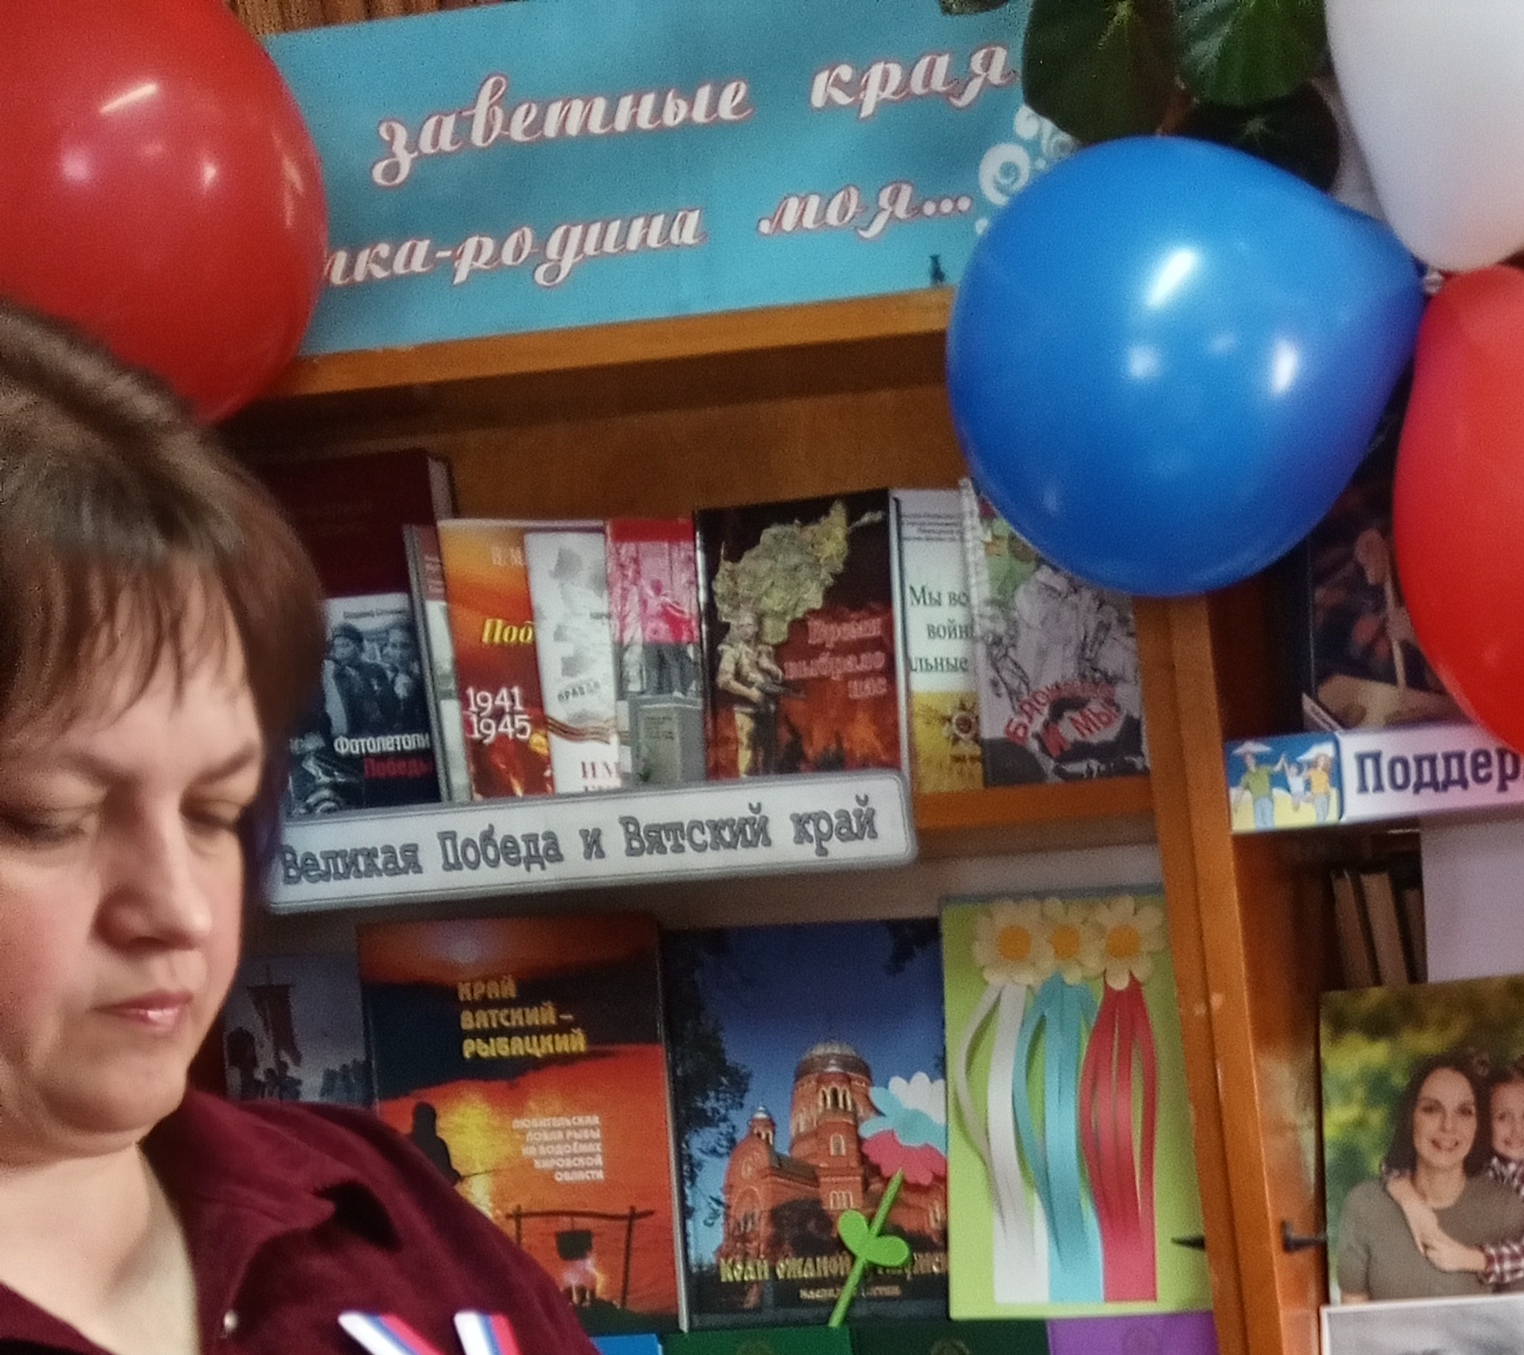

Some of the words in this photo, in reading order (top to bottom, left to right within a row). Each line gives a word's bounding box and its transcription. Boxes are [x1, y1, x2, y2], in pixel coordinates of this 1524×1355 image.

[371, 71, 754, 188] заветные
[809, 41, 1020, 118] края
[757, 176, 974, 240] моя...
[909, 586, 936, 607] Мы
[910, 655, 969, 673] льные
[466, 686, 525, 714] 1941
[469, 715, 532, 745] 1945
[281, 837, 423, 887] Великая
[439, 823, 565, 874] Победа
[580, 826, 606, 861] и
[619, 801, 773, 861] Вятский
[792, 793, 880, 859] край
[457, 974, 517, 1001] КРАЙ
[460, 1001, 557, 1030] ВЯТСКИЙ
[462, 1028, 587, 1059] РЫБАЦКИЙ
[533, 1154, 603, 1169] КИРОВСКОЙ
[554, 1168, 604, 1182] ОБЛАСТИ
